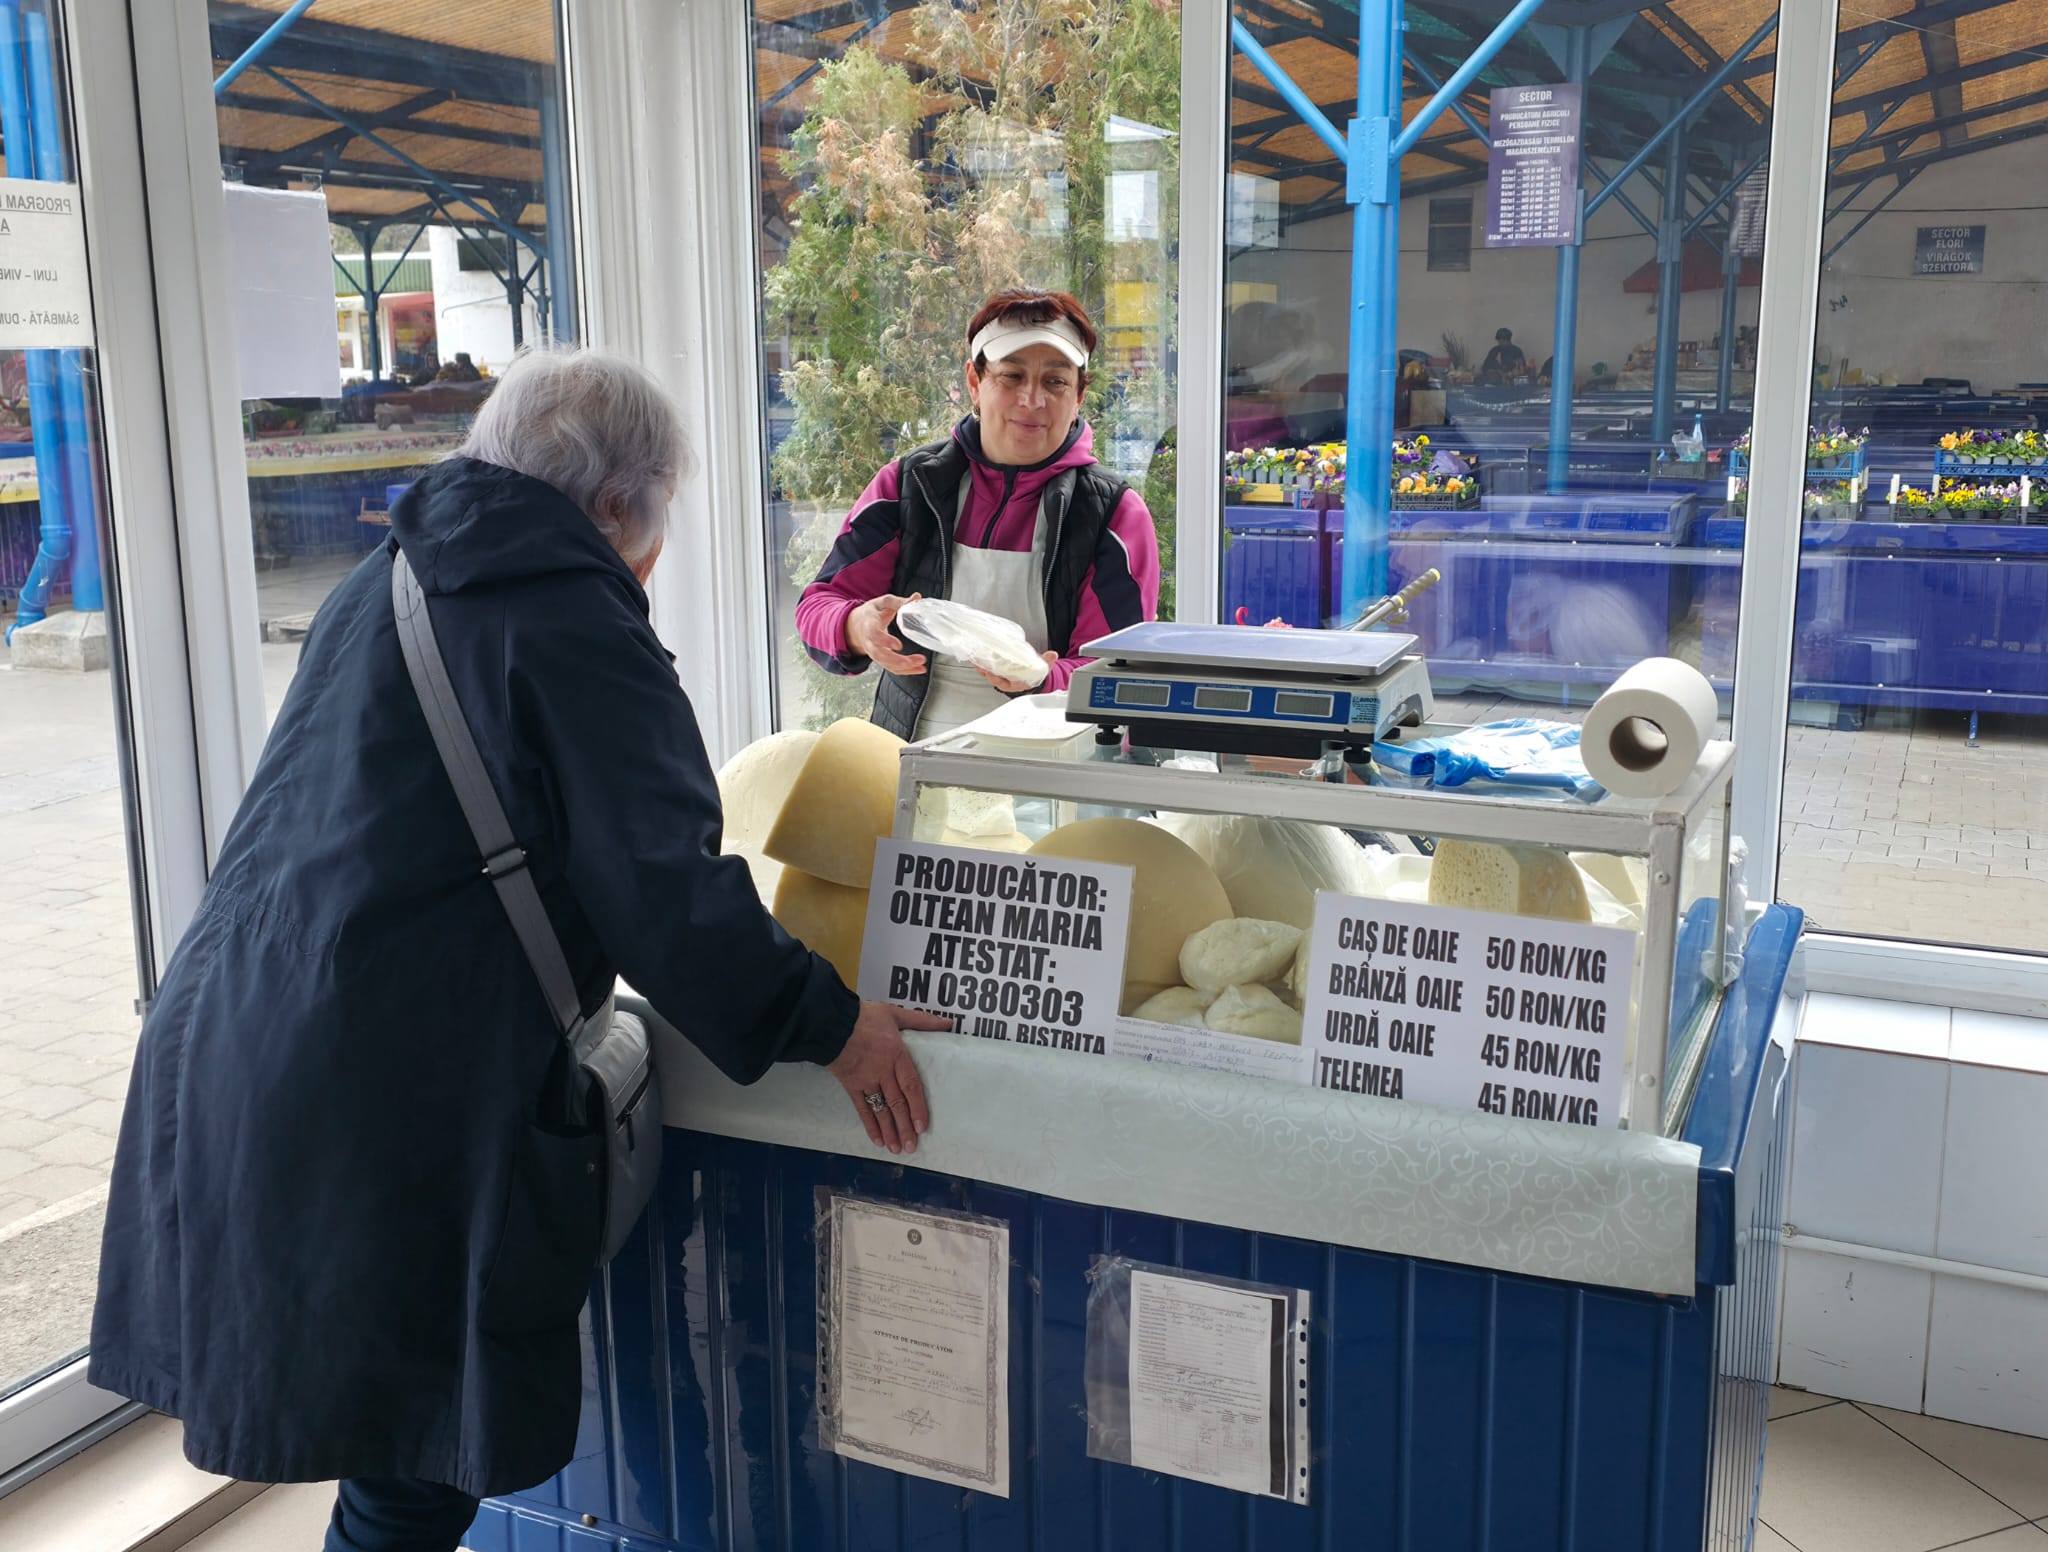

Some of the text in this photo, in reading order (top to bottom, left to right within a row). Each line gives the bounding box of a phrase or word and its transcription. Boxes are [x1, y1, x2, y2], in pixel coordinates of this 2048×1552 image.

[1509, 119, 1560, 129] PERSOANE FIZICE
[1519, 90, 1552, 102] SECTOR
[1931, 227, 1970, 238] SECTOR
[1936, 239, 1964, 248] FLORI
[1922, 262, 1974, 272] SZEKTORA
[894, 852, 1107, 912] PRODUCĂTOR:
[889, 889, 1102, 951] OLTEAN MARIA
[922, 932, 1056, 983] ATESTAT:
[1338, 917, 1607, 984] CAȘ DE OAIE 50 RON/KG
[889, 965, 931, 1005] BN
[937, 972, 1084, 1027] 0380303
[1328, 960, 1607, 1034] BRÂNZĂ OAIE 50 RON/KG
[1325, 1009, 1601, 1083] URDĂ OAIE 45 RON/KG
[1320, 1055, 1404, 1100] TELEMEA
[1477, 1082, 1506, 1115] 45
[1511, 1087, 1598, 1127] RON/KG
